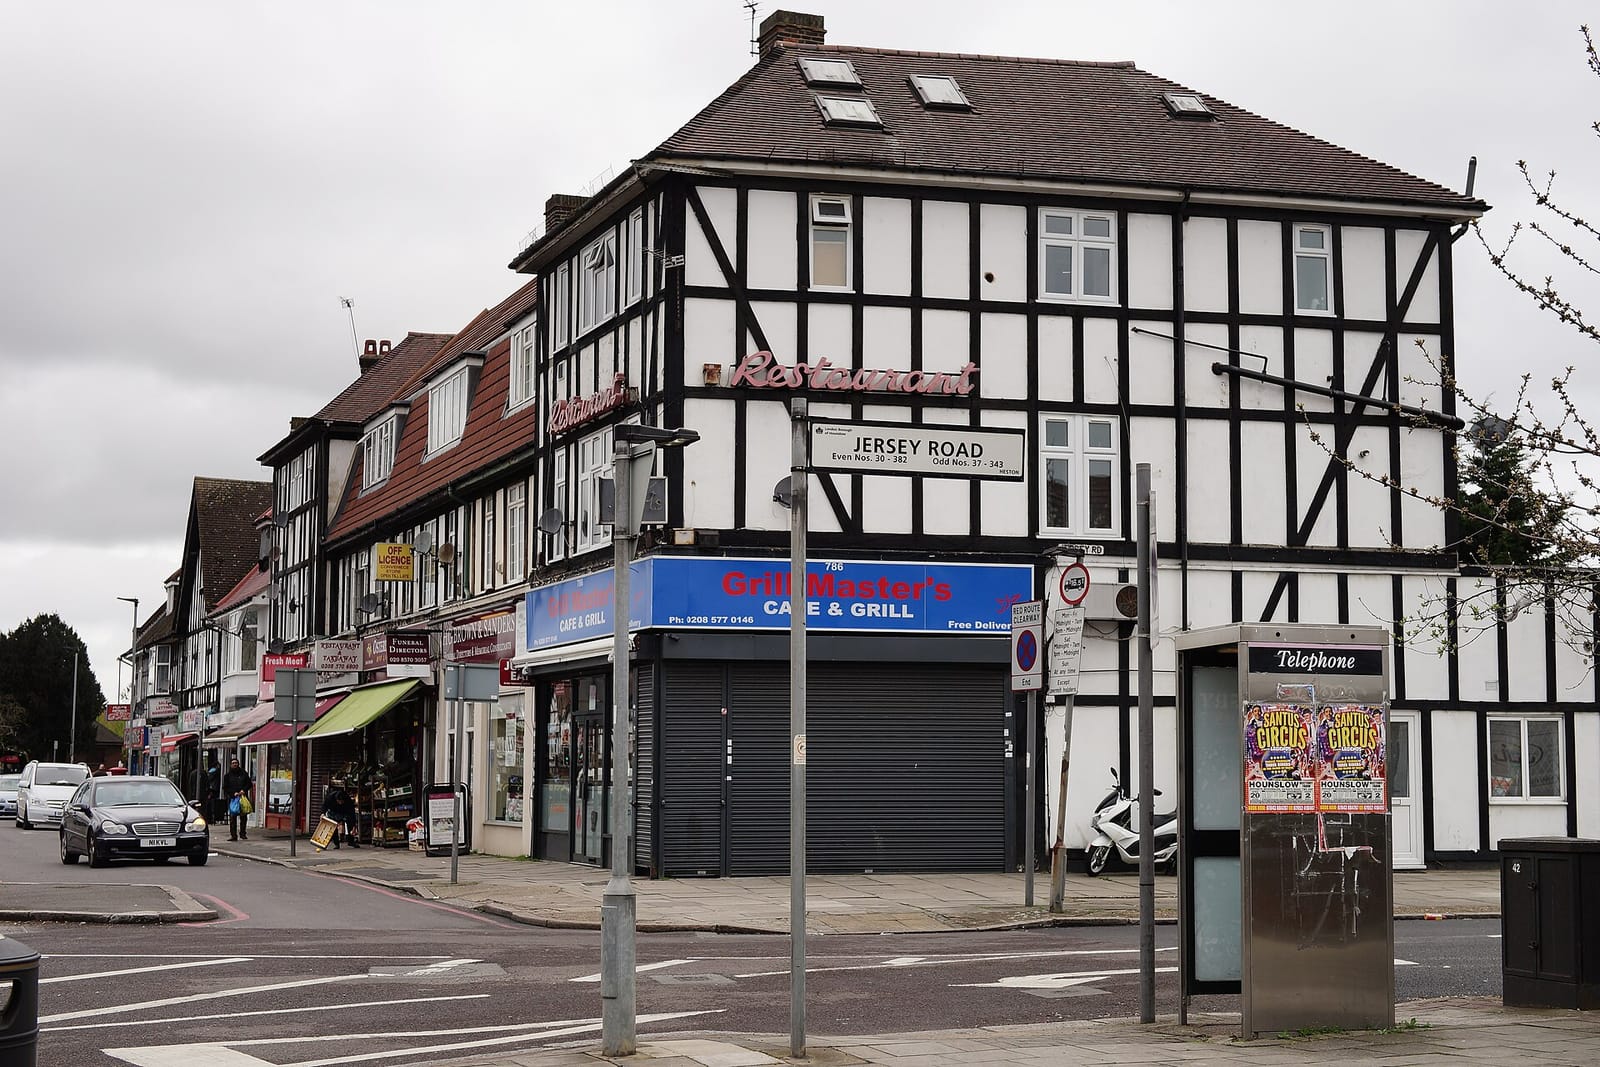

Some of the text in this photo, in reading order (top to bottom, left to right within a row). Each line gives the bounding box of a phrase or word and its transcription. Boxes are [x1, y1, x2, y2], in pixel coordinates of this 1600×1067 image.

[731, 350, 981, 395] Restaurant
[546, 371, 626, 435] Restaurant
[853, 437, 984, 458] JERSEY ROAD
[832, 453, 852, 461] Even
[854, 454, 873, 462] Nos.
[876, 454, 885, 463] 30
[893, 455, 908, 464] 382
[933, 457, 950, 466] Odd
[952, 458, 970, 467] Nos.
[972, 460, 982, 468] 37
[989, 460, 1004, 469] 343
[388, 546, 402, 555] OFF
[1092, 546, 1103, 554] RD
[378, 555, 412, 565] LICENCE
[825, 562, 844, 571] 786
[807, 572, 953, 601] Master's
[763, 600, 914, 619] CAE & GRILL
[1013, 604, 1041, 615] RED ROUTE
[560, 611, 606, 633] CAFE & GRILL
[669, 616, 754, 625] Ph: 0208 577 0146
[1013, 613, 1040, 625] CLEARWAY
[453, 622, 477, 645] BROWN
[477, 621, 482, 639] &
[483, 612, 515, 638] SANDERS
[948, 620, 1013, 631] Free Deliver
[392, 638, 423, 646] FUNERAL
[265, 656, 303, 665] Fresh Meat
[1277, 651, 1356, 671] Telephone
[1022, 678, 1031, 687] End
[1263, 711, 1300, 728] SANTUS
[1334, 711, 1370, 728] SANTUS
[1256, 726, 1307, 750] CIRCUS
[1328, 726, 1377, 750] CIRCUS
[1512, 863, 1521, 873] 42
